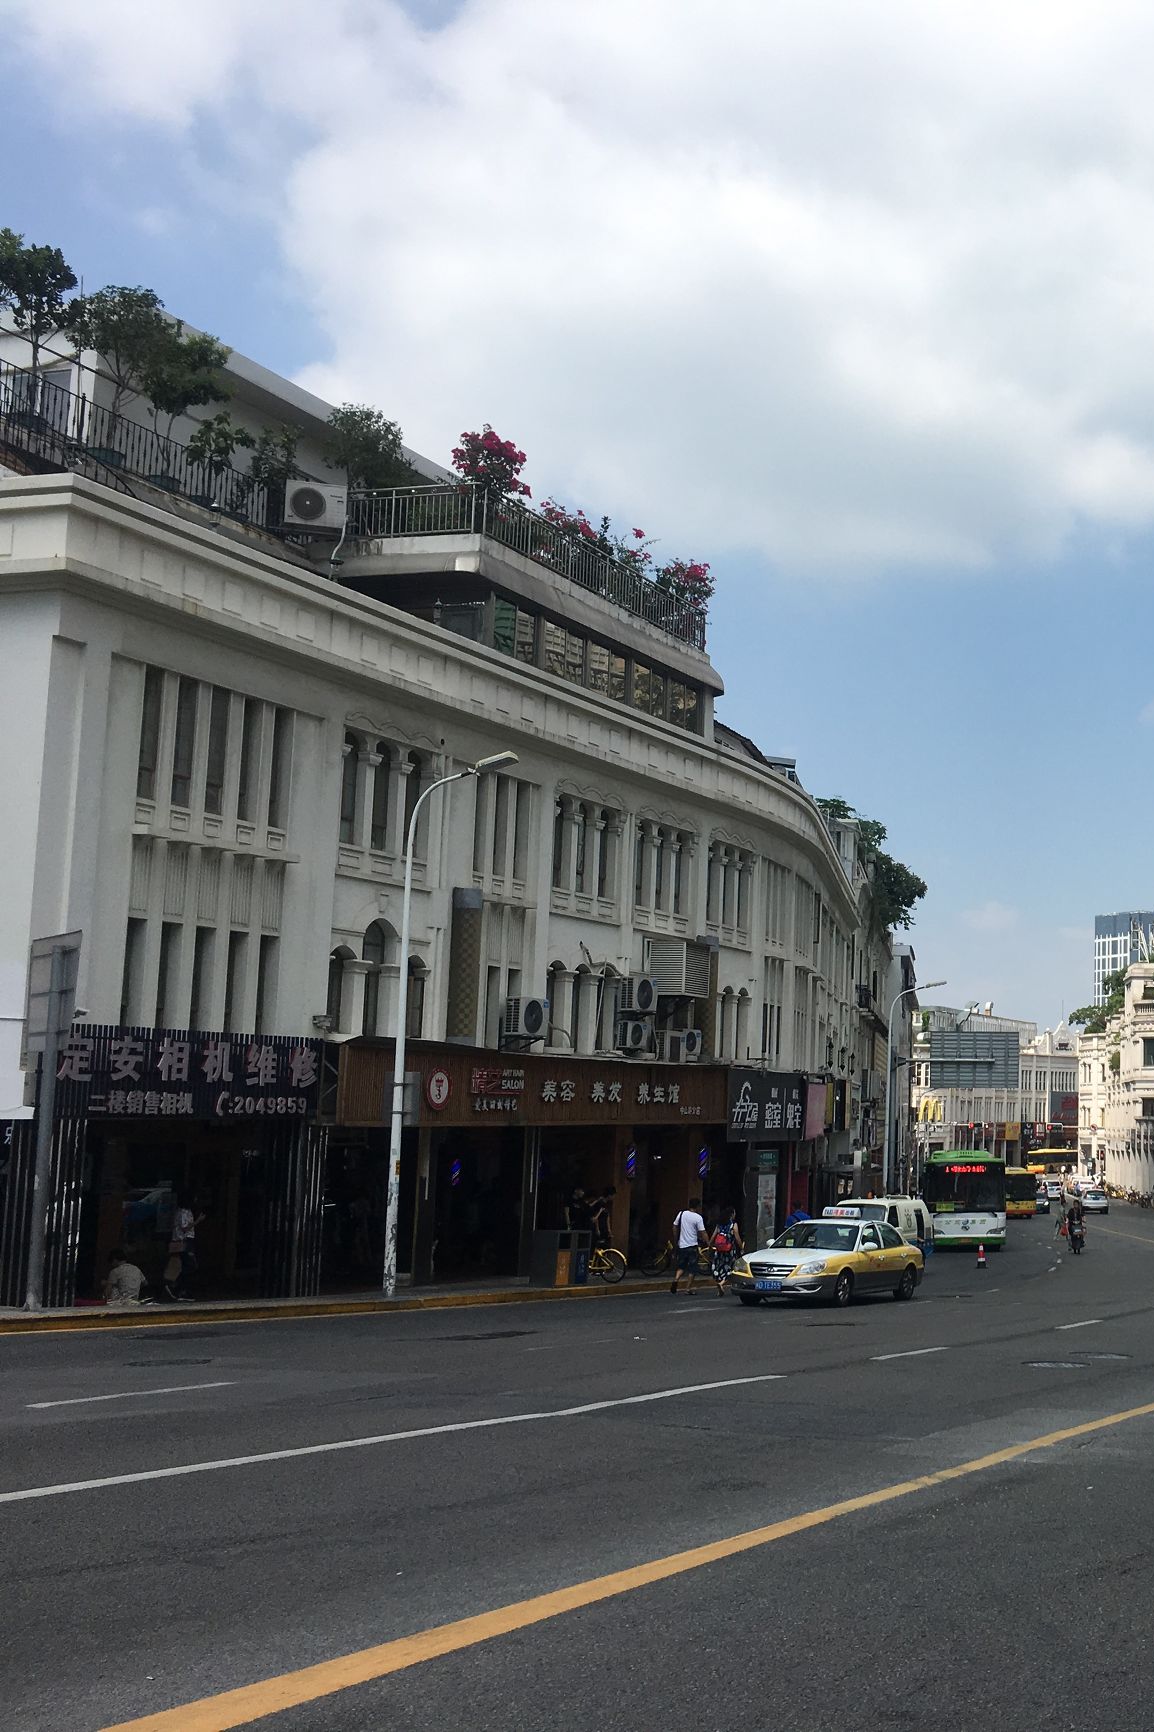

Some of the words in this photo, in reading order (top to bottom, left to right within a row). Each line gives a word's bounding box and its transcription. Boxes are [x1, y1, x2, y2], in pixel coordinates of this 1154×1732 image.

[56, 1031, 318, 1088] 定安相机维修
[501, 1079, 525, 1090] SALON
[542, 1080, 576, 1102] 美容
[591, 1081, 622, 1103] 美发
